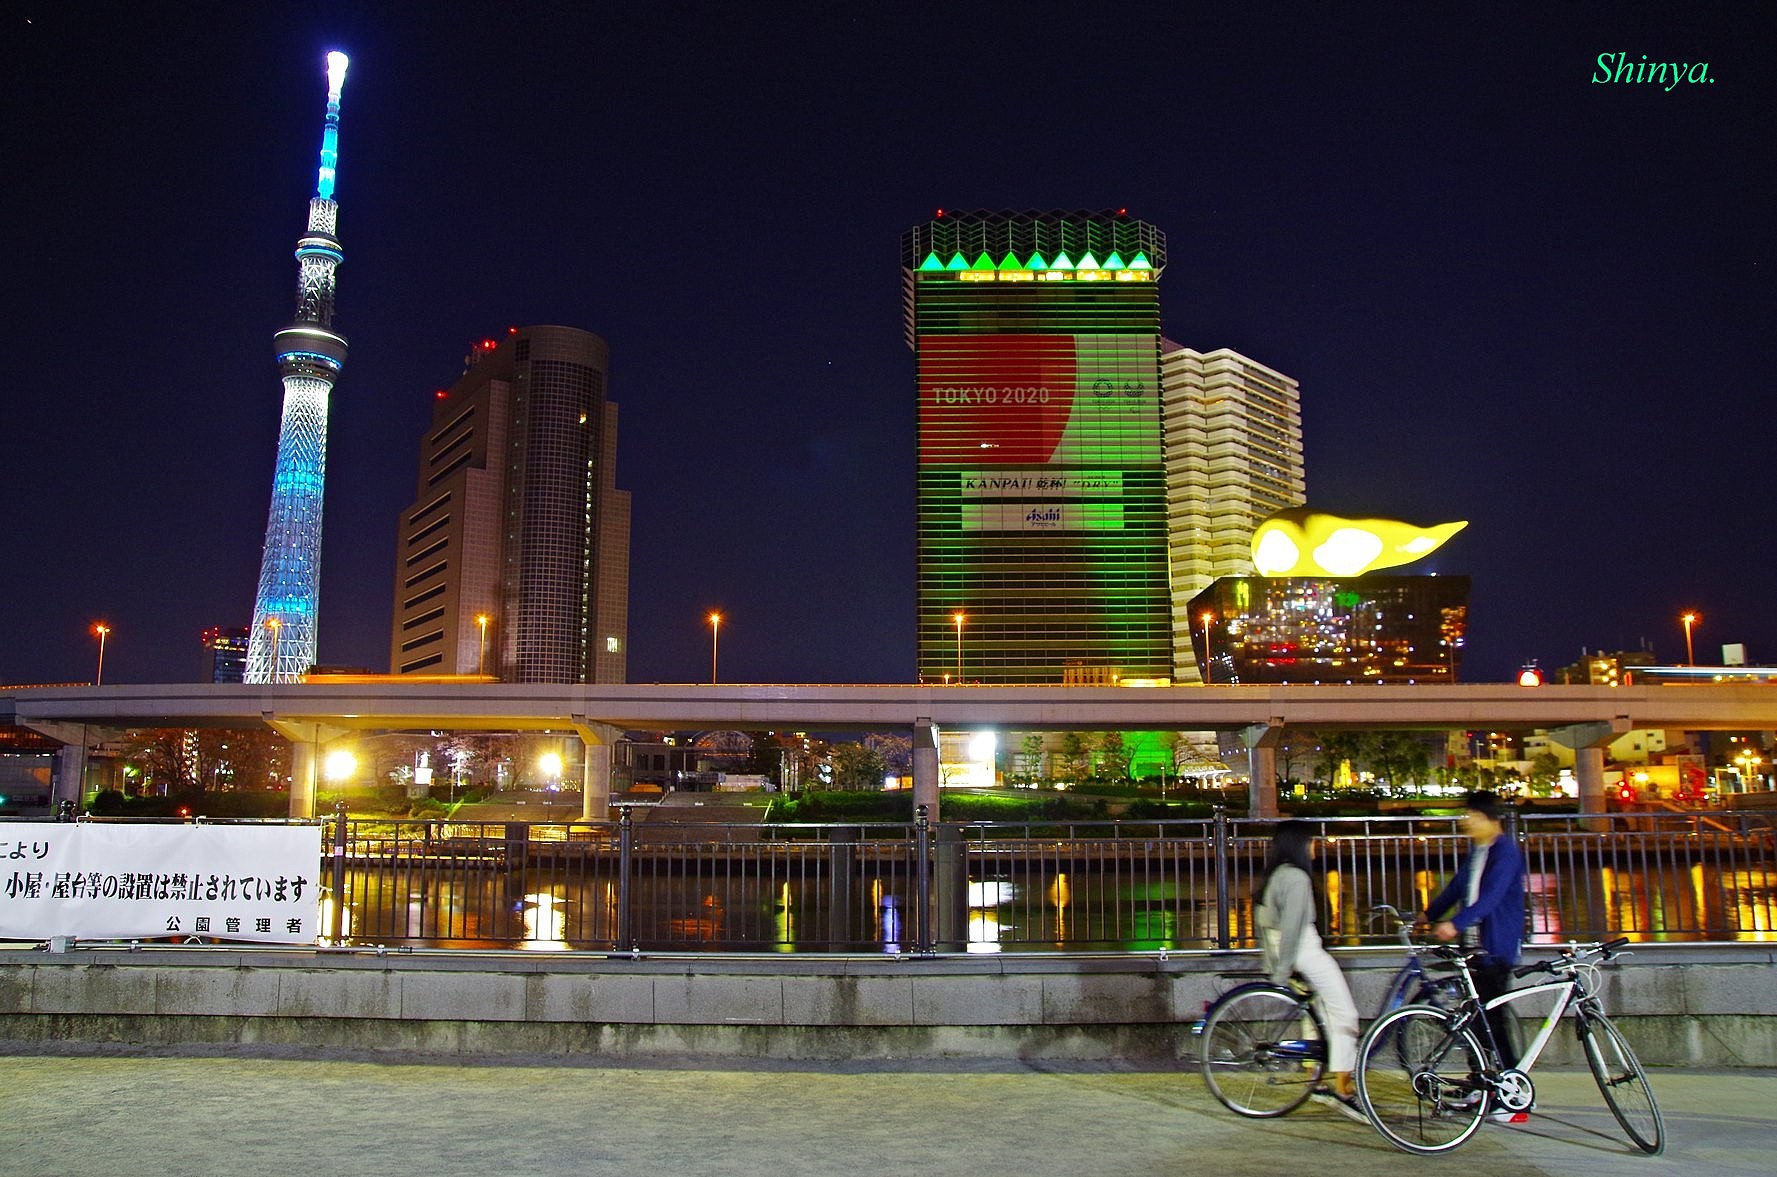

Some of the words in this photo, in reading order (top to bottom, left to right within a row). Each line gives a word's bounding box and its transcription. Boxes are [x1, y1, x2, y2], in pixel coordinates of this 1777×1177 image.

[932, 387, 997, 404] TOKYO
[1002, 387, 1049, 404] 2020
[1026, 508, 1060, 521] Asahi
[166, 915, 302, 934] 公園管理者
